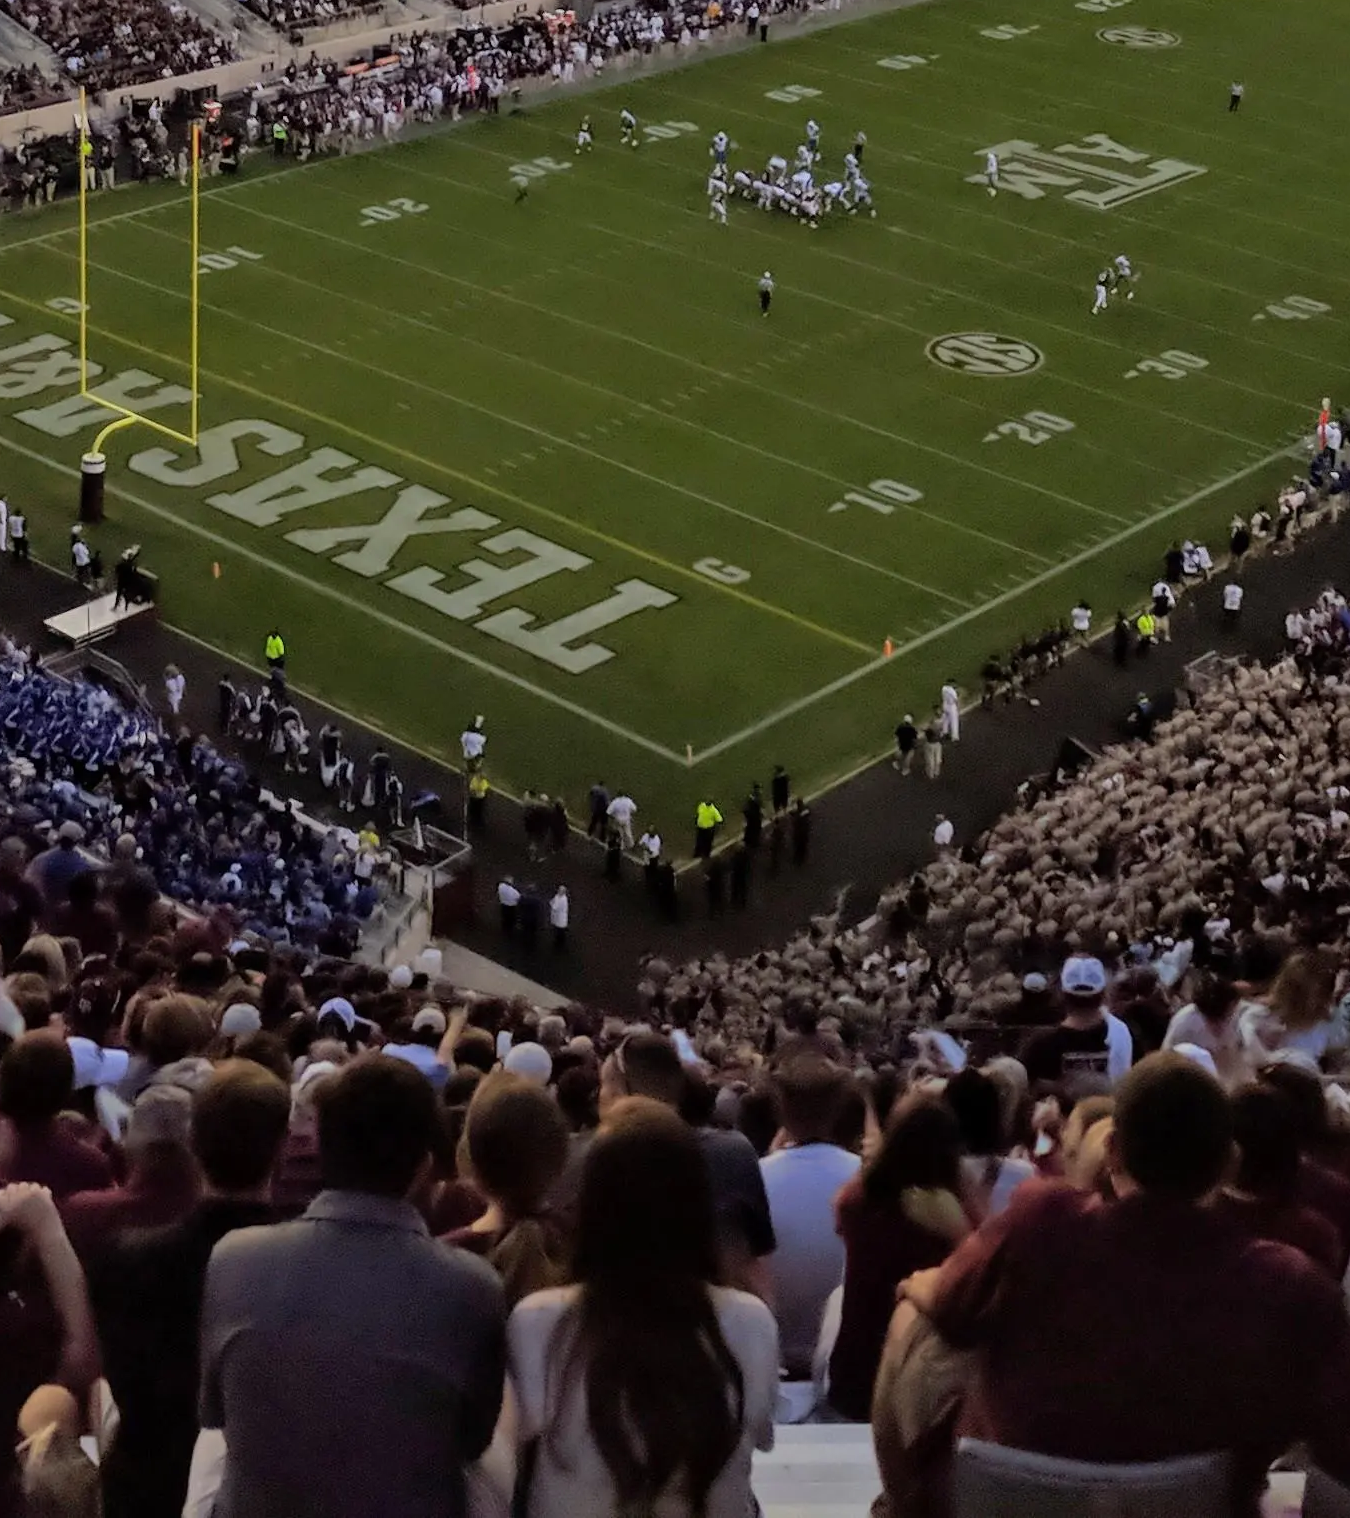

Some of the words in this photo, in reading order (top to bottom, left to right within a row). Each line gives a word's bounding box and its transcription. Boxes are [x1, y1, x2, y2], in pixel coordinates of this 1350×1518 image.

[360, 197, 429, 222] 20
[197, 245, 263, 270] 10
[1265, 295, 1332, 320] 40
[1136, 349, 1209, 380] 30
[997, 411, 1075, 445] 20
[844, 479, 923, 515] 10
[129, 416, 680, 675] TEXAS
[692, 557, 751, 583] G
